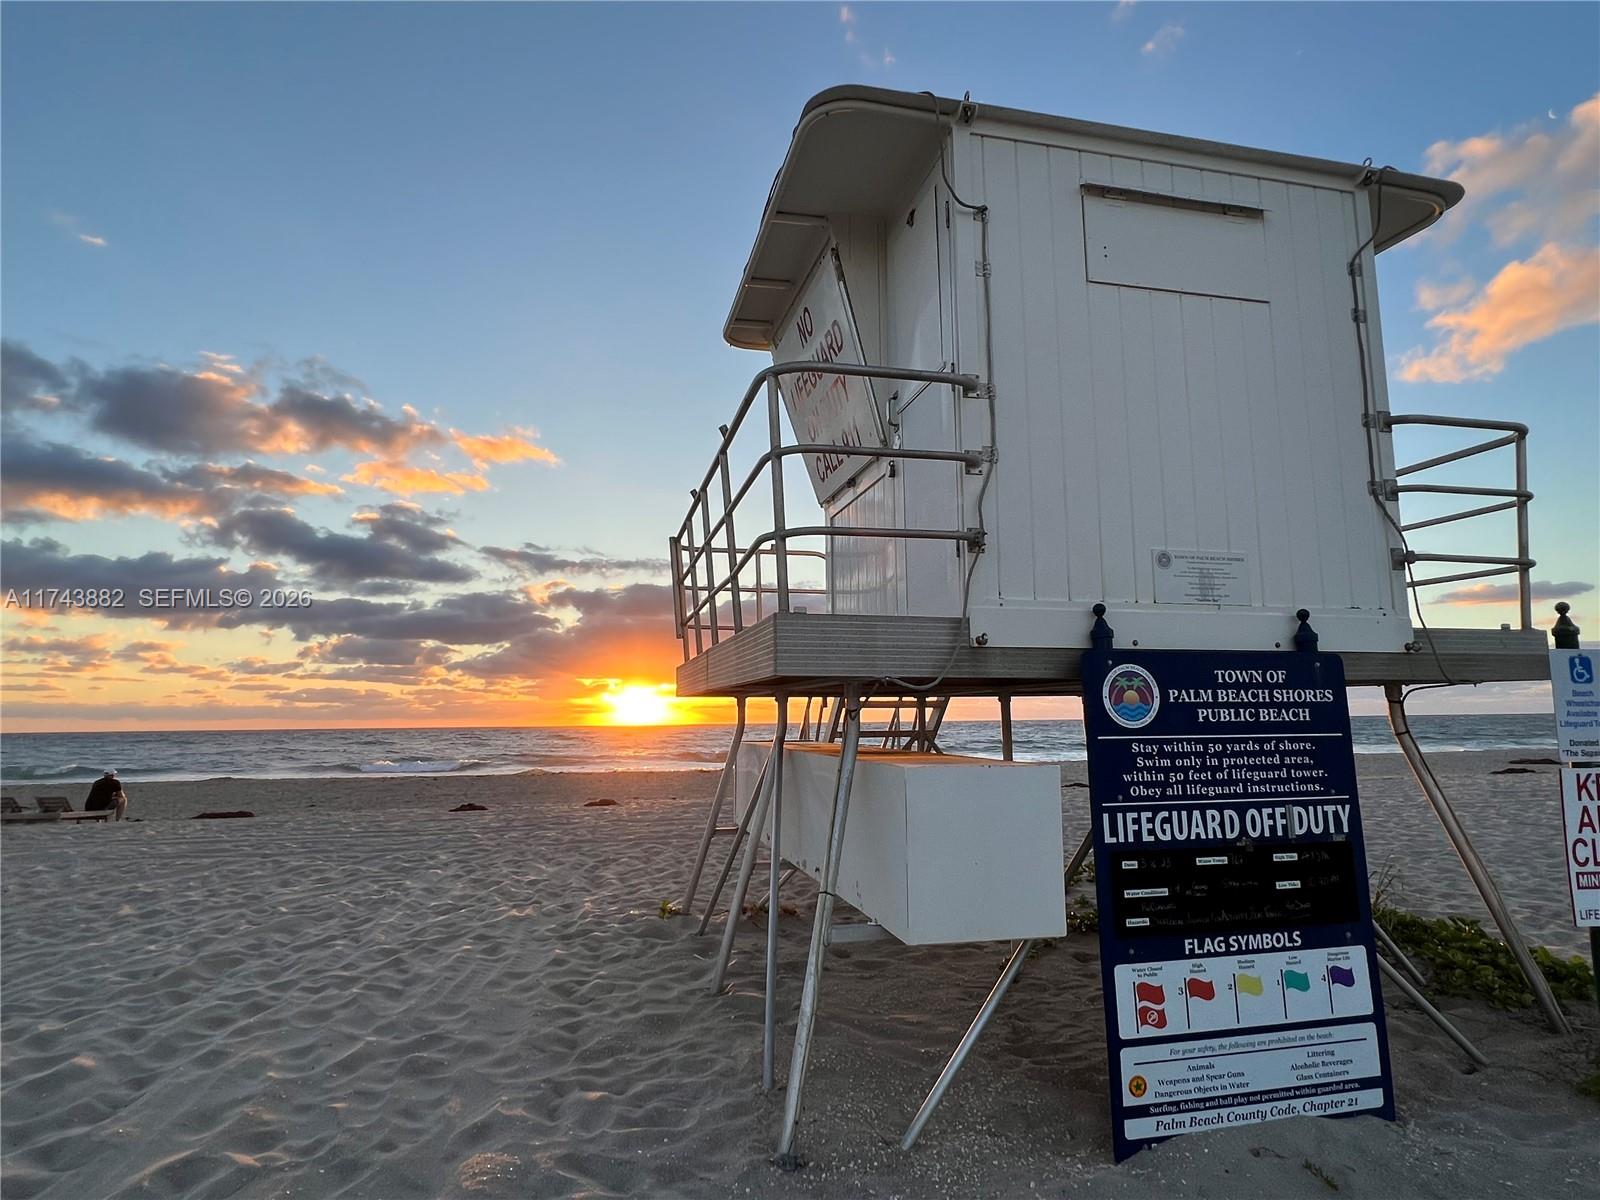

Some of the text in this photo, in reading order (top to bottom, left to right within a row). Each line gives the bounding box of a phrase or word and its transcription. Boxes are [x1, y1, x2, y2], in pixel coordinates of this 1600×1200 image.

[796, 306, 813, 350] NO
[816, 438, 844, 483] CALL
[1214, 669, 1287, 683] TOWN OF
[1168, 688, 1334, 703] PALM BEACH SHORES
[1197, 707, 1311, 722] PUBLIC BEACH
[1560, 720, 1593, 729] Lifeguard
[1131, 739, 1316, 755] Stay within 50 yards of shore.
[1136, 753, 1314, 768] Swim only in protected area,
[1122, 767, 1328, 783] within 50 feet of lifeguard tower.
[1130, 781, 1324, 798] Obey all lifeguard instructions.
[1102, 804, 1351, 844] LIFEGUARD OFF DUTY
[1184, 930, 1302, 955] FLAG SYMBOLS
[1178, 987, 1184, 996] 3
[1227, 983, 1233, 991] 2
[1169, 1048, 1180, 1056] For
[1181, 1047, 1197, 1056] your
[1218, 1042, 1228, 1050] the
[1267, 1035, 1298, 1047] prohibited
[1306, 1033, 1316, 1041] the
[1307, 1049, 1335, 1059] Littering
[1187, 1062, 1215, 1072] Animals
[1290, 1058, 1354, 1072] Alcoholic Beverages
[1158, 1070, 1245, 1087] Weapons and Spear Guns
[1295, 1069, 1350, 1081] Glass Containers
[1149, 1081, 1361, 1114] Surfing, fishing and ball play not permitted within guarded area.
[1154, 1081, 1250, 1099] Dangerous Objects in Water
[1156, 1096, 1359, 1132] Palm Beach County Code, Chapter 21
